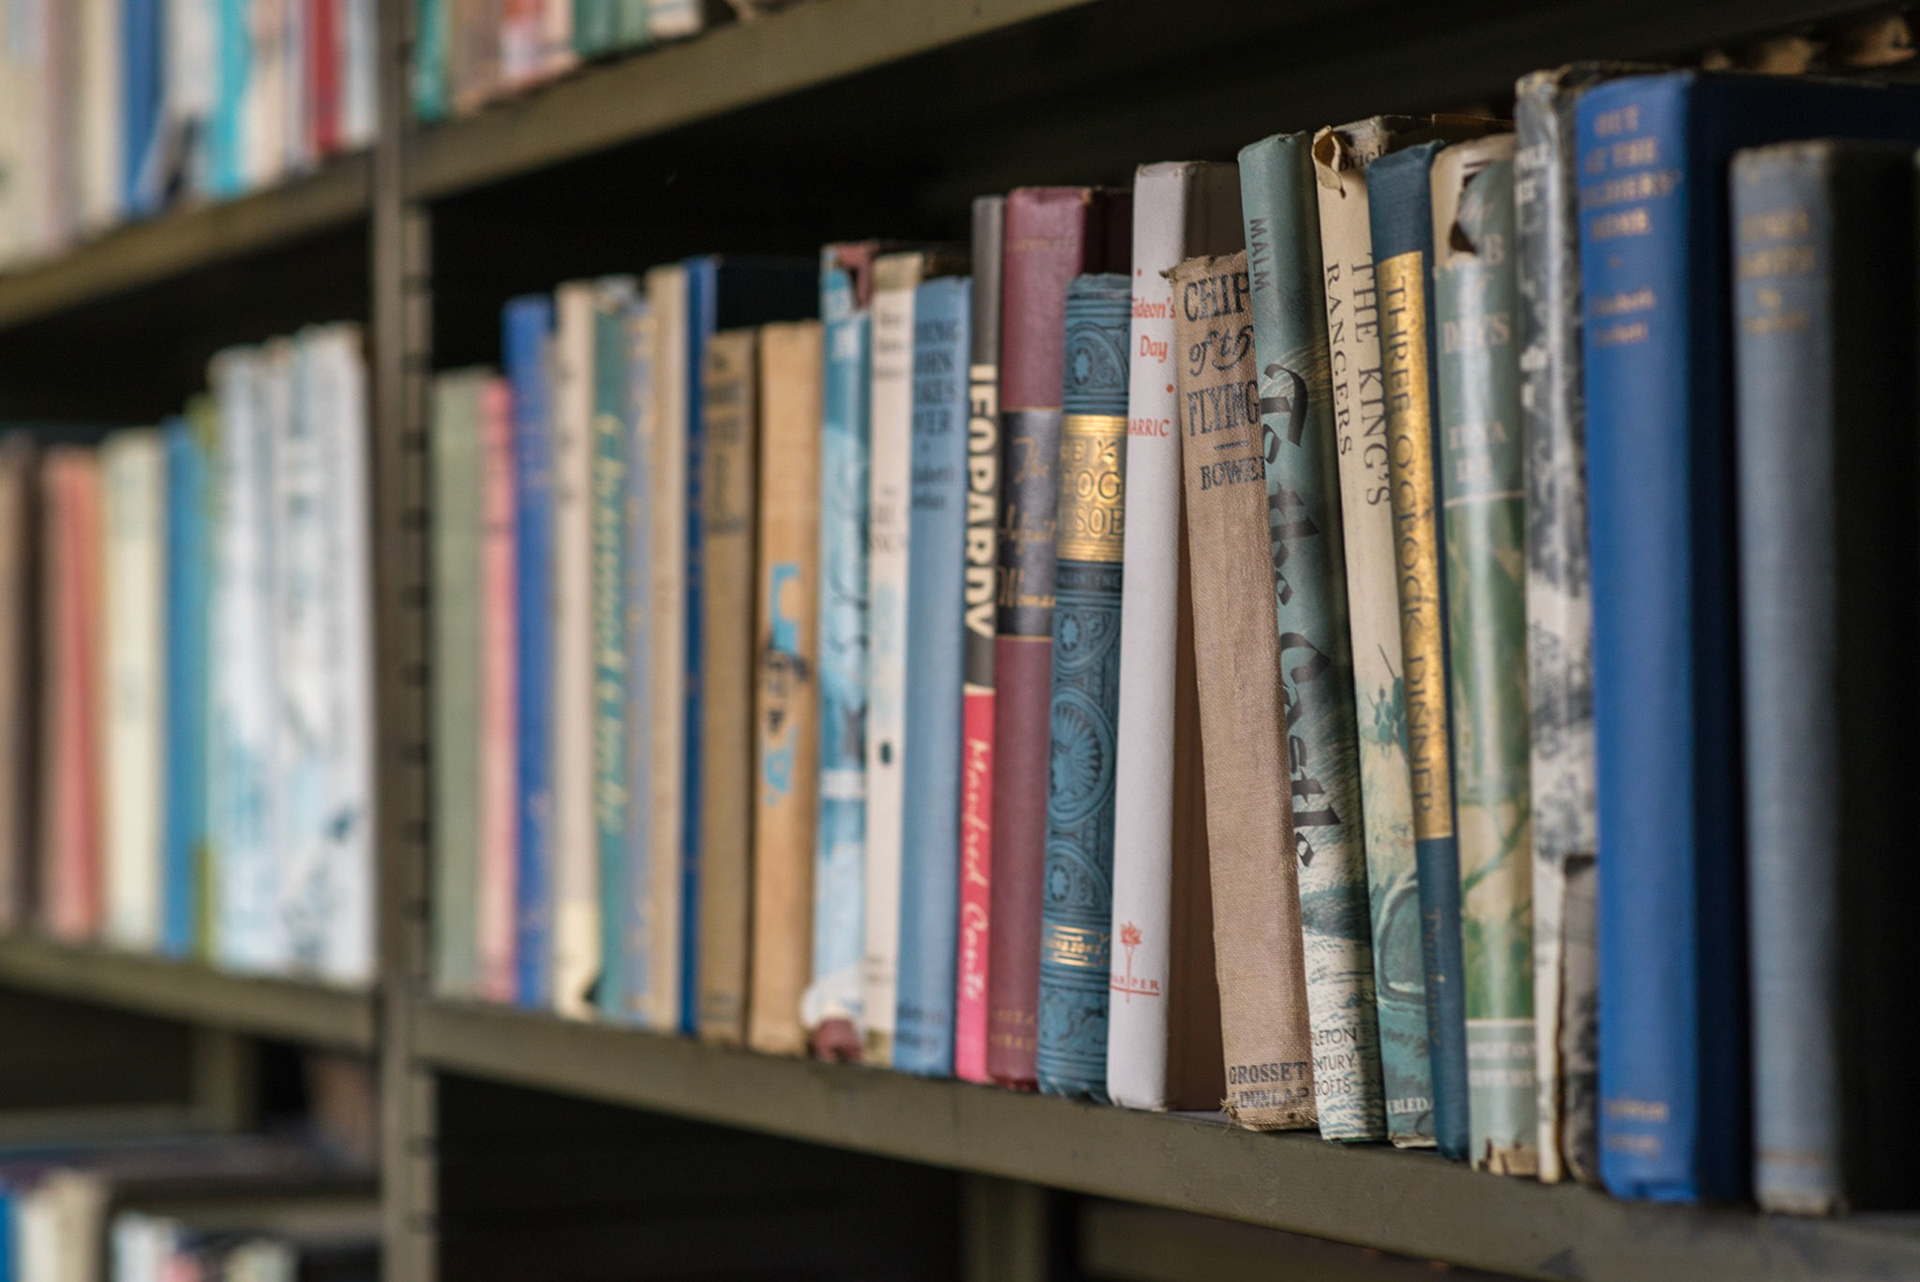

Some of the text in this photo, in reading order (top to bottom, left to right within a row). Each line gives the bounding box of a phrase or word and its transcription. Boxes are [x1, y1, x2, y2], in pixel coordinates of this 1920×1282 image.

[1249, 217, 1271, 292] MALM
[1183, 271, 1250, 322] CHIP
[1140, 334, 1168, 363] Day
[1189, 325, 1256, 377] of th
[1326, 262, 1352, 456] RANGERS
[1351, 252, 1390, 507] THE KING'S
[1187, 380, 1259, 437] FLYING
[1228, 1061, 1308, 1085] GROSSET
[1312, 1053, 1356, 1071] NTURY
